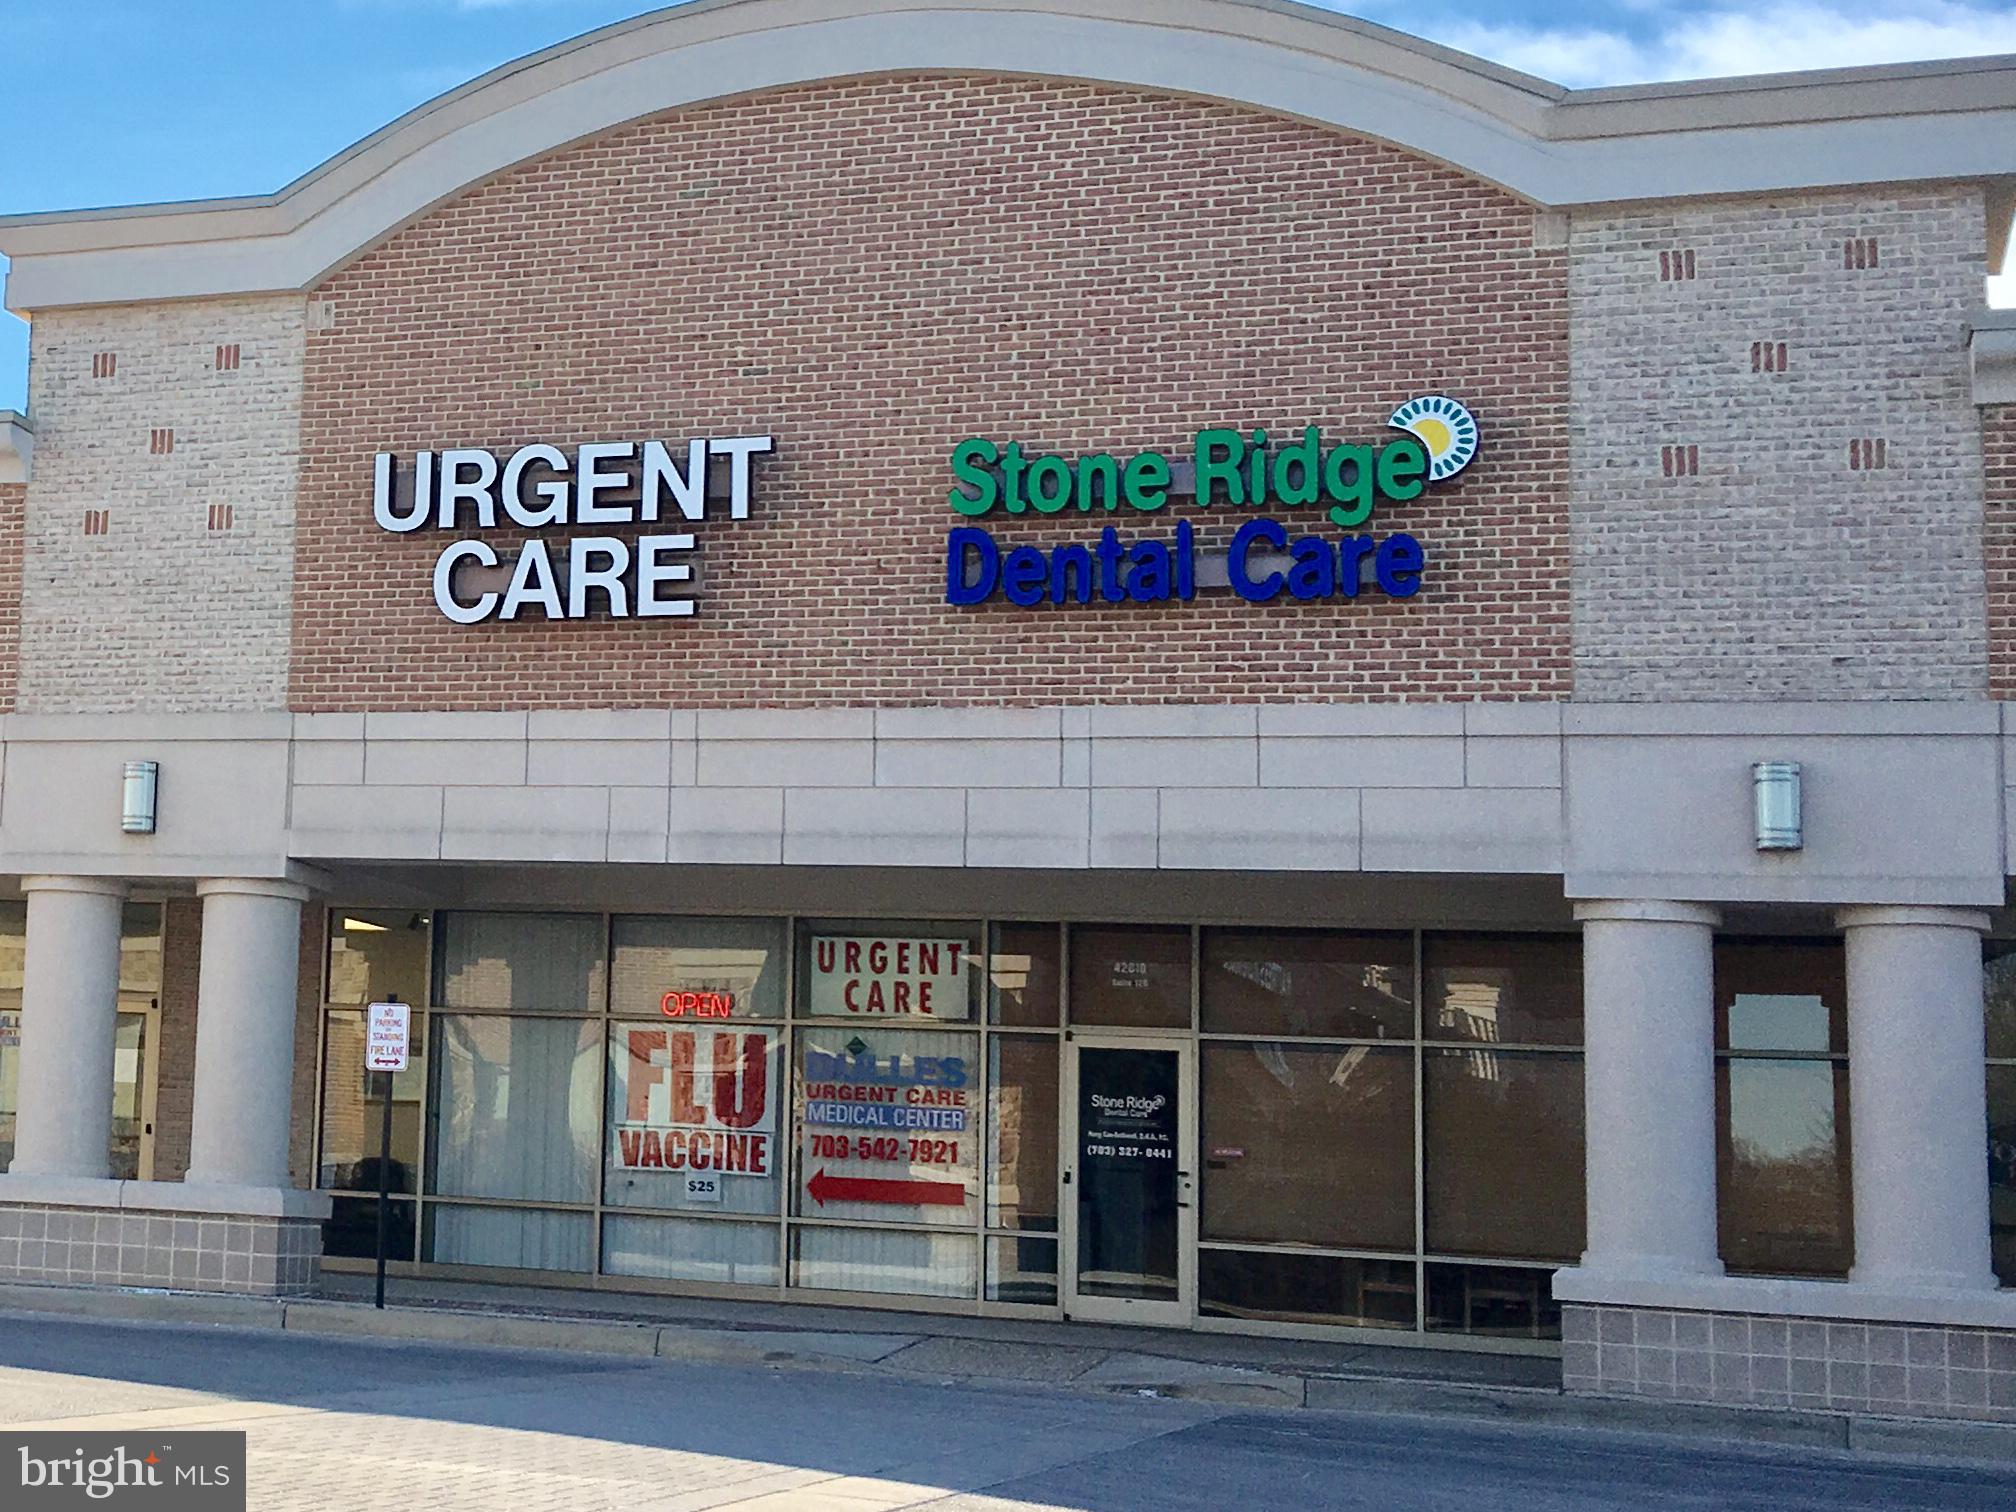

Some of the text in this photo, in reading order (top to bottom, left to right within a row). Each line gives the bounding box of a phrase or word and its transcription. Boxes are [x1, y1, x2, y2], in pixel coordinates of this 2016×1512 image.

[373, 436, 774, 532] URGENT
[948, 425, 1427, 527] Stone Ridge
[432, 533, 697, 625] CARE
[945, 518, 1426, 606] Dental Care
[817, 940, 962, 976] URGENT
[662, 991, 732, 1018] OPEN
[844, 978, 933, 1015] CARE
[371, 1044, 405, 1057] FIRE LANE
[626, 1030, 768, 1129] FLU
[805, 1050, 968, 1088] DULLES
[805, 1083, 967, 1107] URGENT CARE
[1091, 1094, 1160, 1113] Stone Ridge
[808, 1103, 964, 1130] MEDICAL CENTER
[618, 1129, 768, 1174] VACCINE
[810, 1134, 959, 1165] 703-542-7921
[687, 1180, 715, 1193] $25
